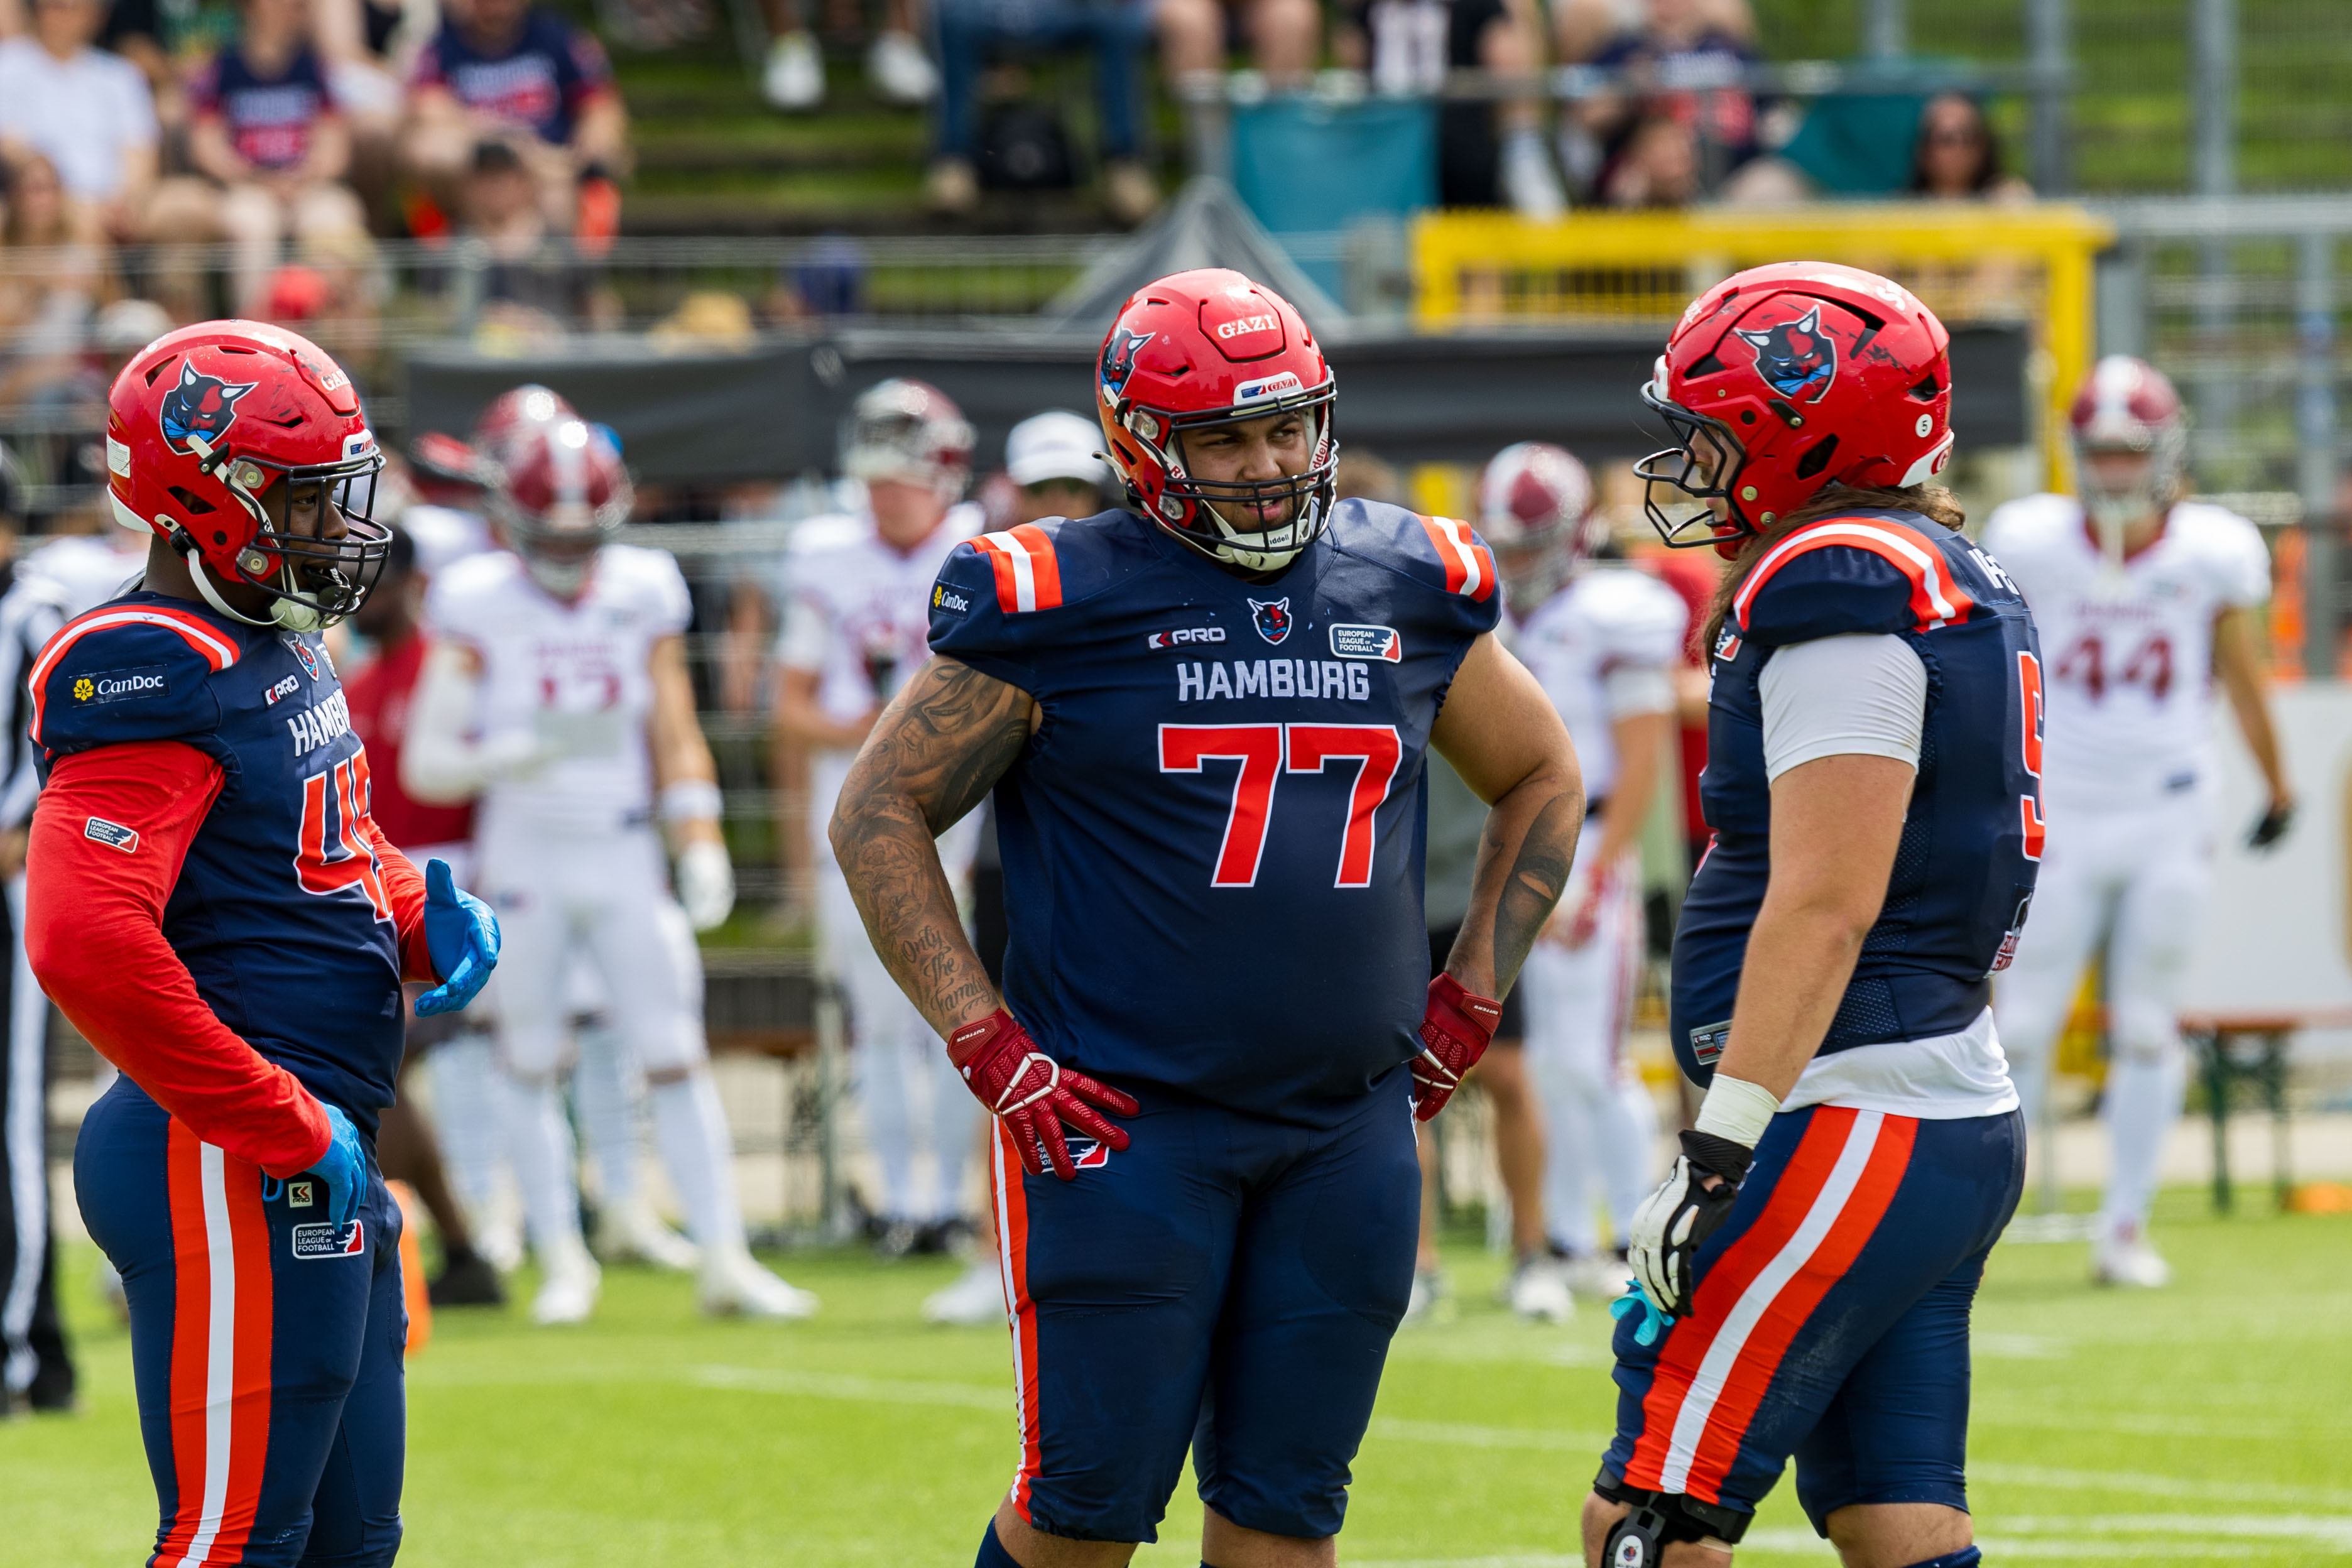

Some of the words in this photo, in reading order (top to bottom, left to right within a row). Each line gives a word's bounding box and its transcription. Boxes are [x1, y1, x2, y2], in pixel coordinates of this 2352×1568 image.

[1217, 314, 1277, 339] GAZI
[1270, 378, 1295, 391] GAZI
[1922, 420, 1928, 432] 5
[941, 591, 969, 612] CanDoc
[1339, 644, 1374, 652] FOOTBALL
[97, 675, 164, 695] CanDoc
[1177, 659, 1370, 702] HAMBURG
[1158, 722, 1403, 888] 77
[90, 825, 110, 836] LEAGUE
[91, 820, 119, 833] EUROPEAN
[89, 830, 114, 842] FOOTBALL
[902, 925, 942, 964] Only
[923, 945, 960, 988] The
[930, 974, 991, 1024] Family
[956, 1028, 986, 1043] CUTTERS
[298, 1228, 335, 1237] EUROPEAN
[298, 1236, 325, 1244] LEAGUE
[298, 1243, 335, 1252] FOOTBALL
